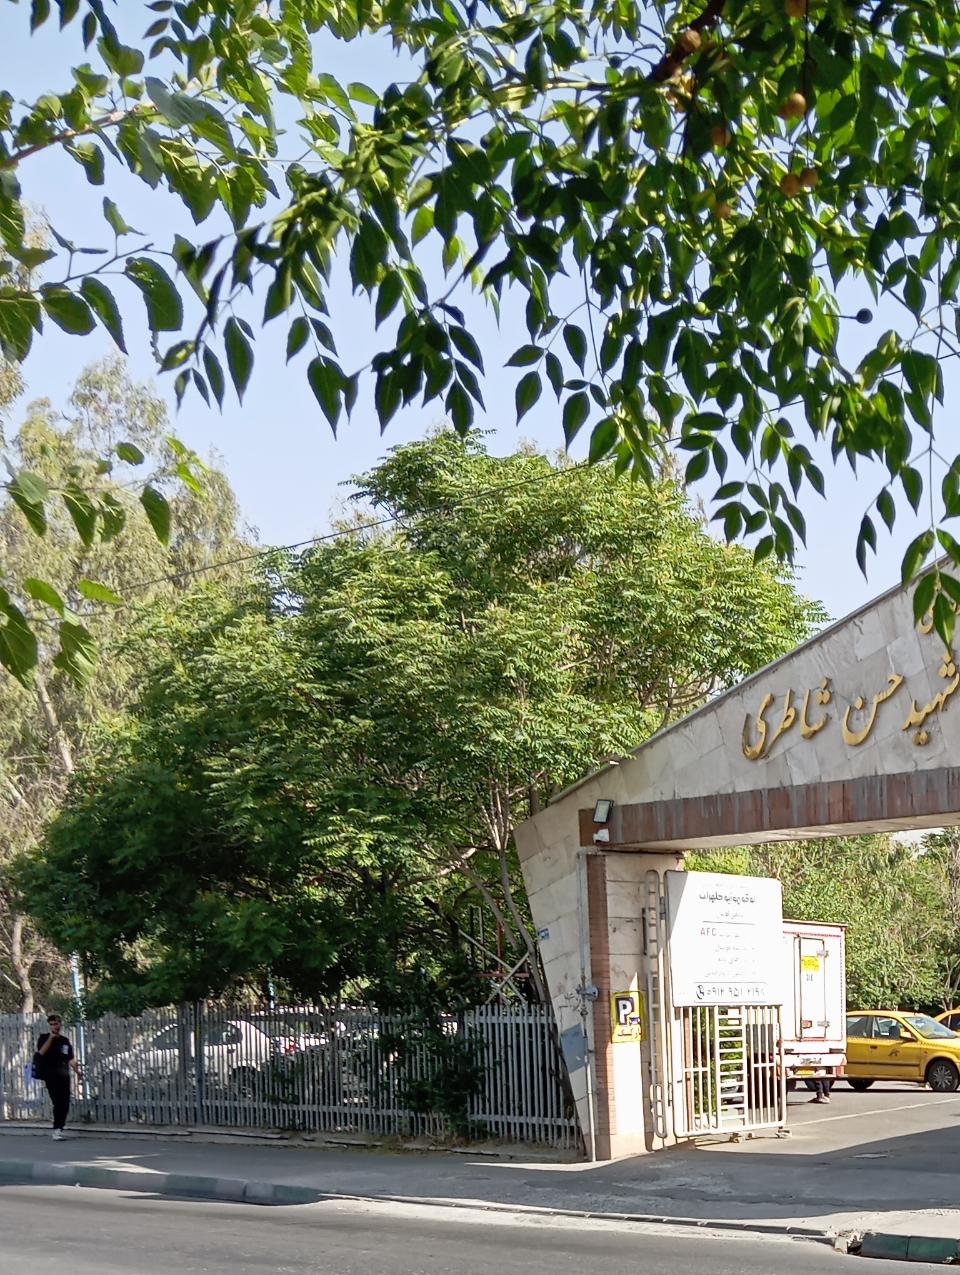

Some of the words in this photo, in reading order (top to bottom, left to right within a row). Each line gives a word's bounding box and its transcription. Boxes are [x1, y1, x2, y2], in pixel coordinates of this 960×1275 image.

[741, 675, 833, 761] شاطری
[842, 672, 904, 747] حسن
[700, 927, 716, 936] AFC
[619, 1000, 632, 1024] P
